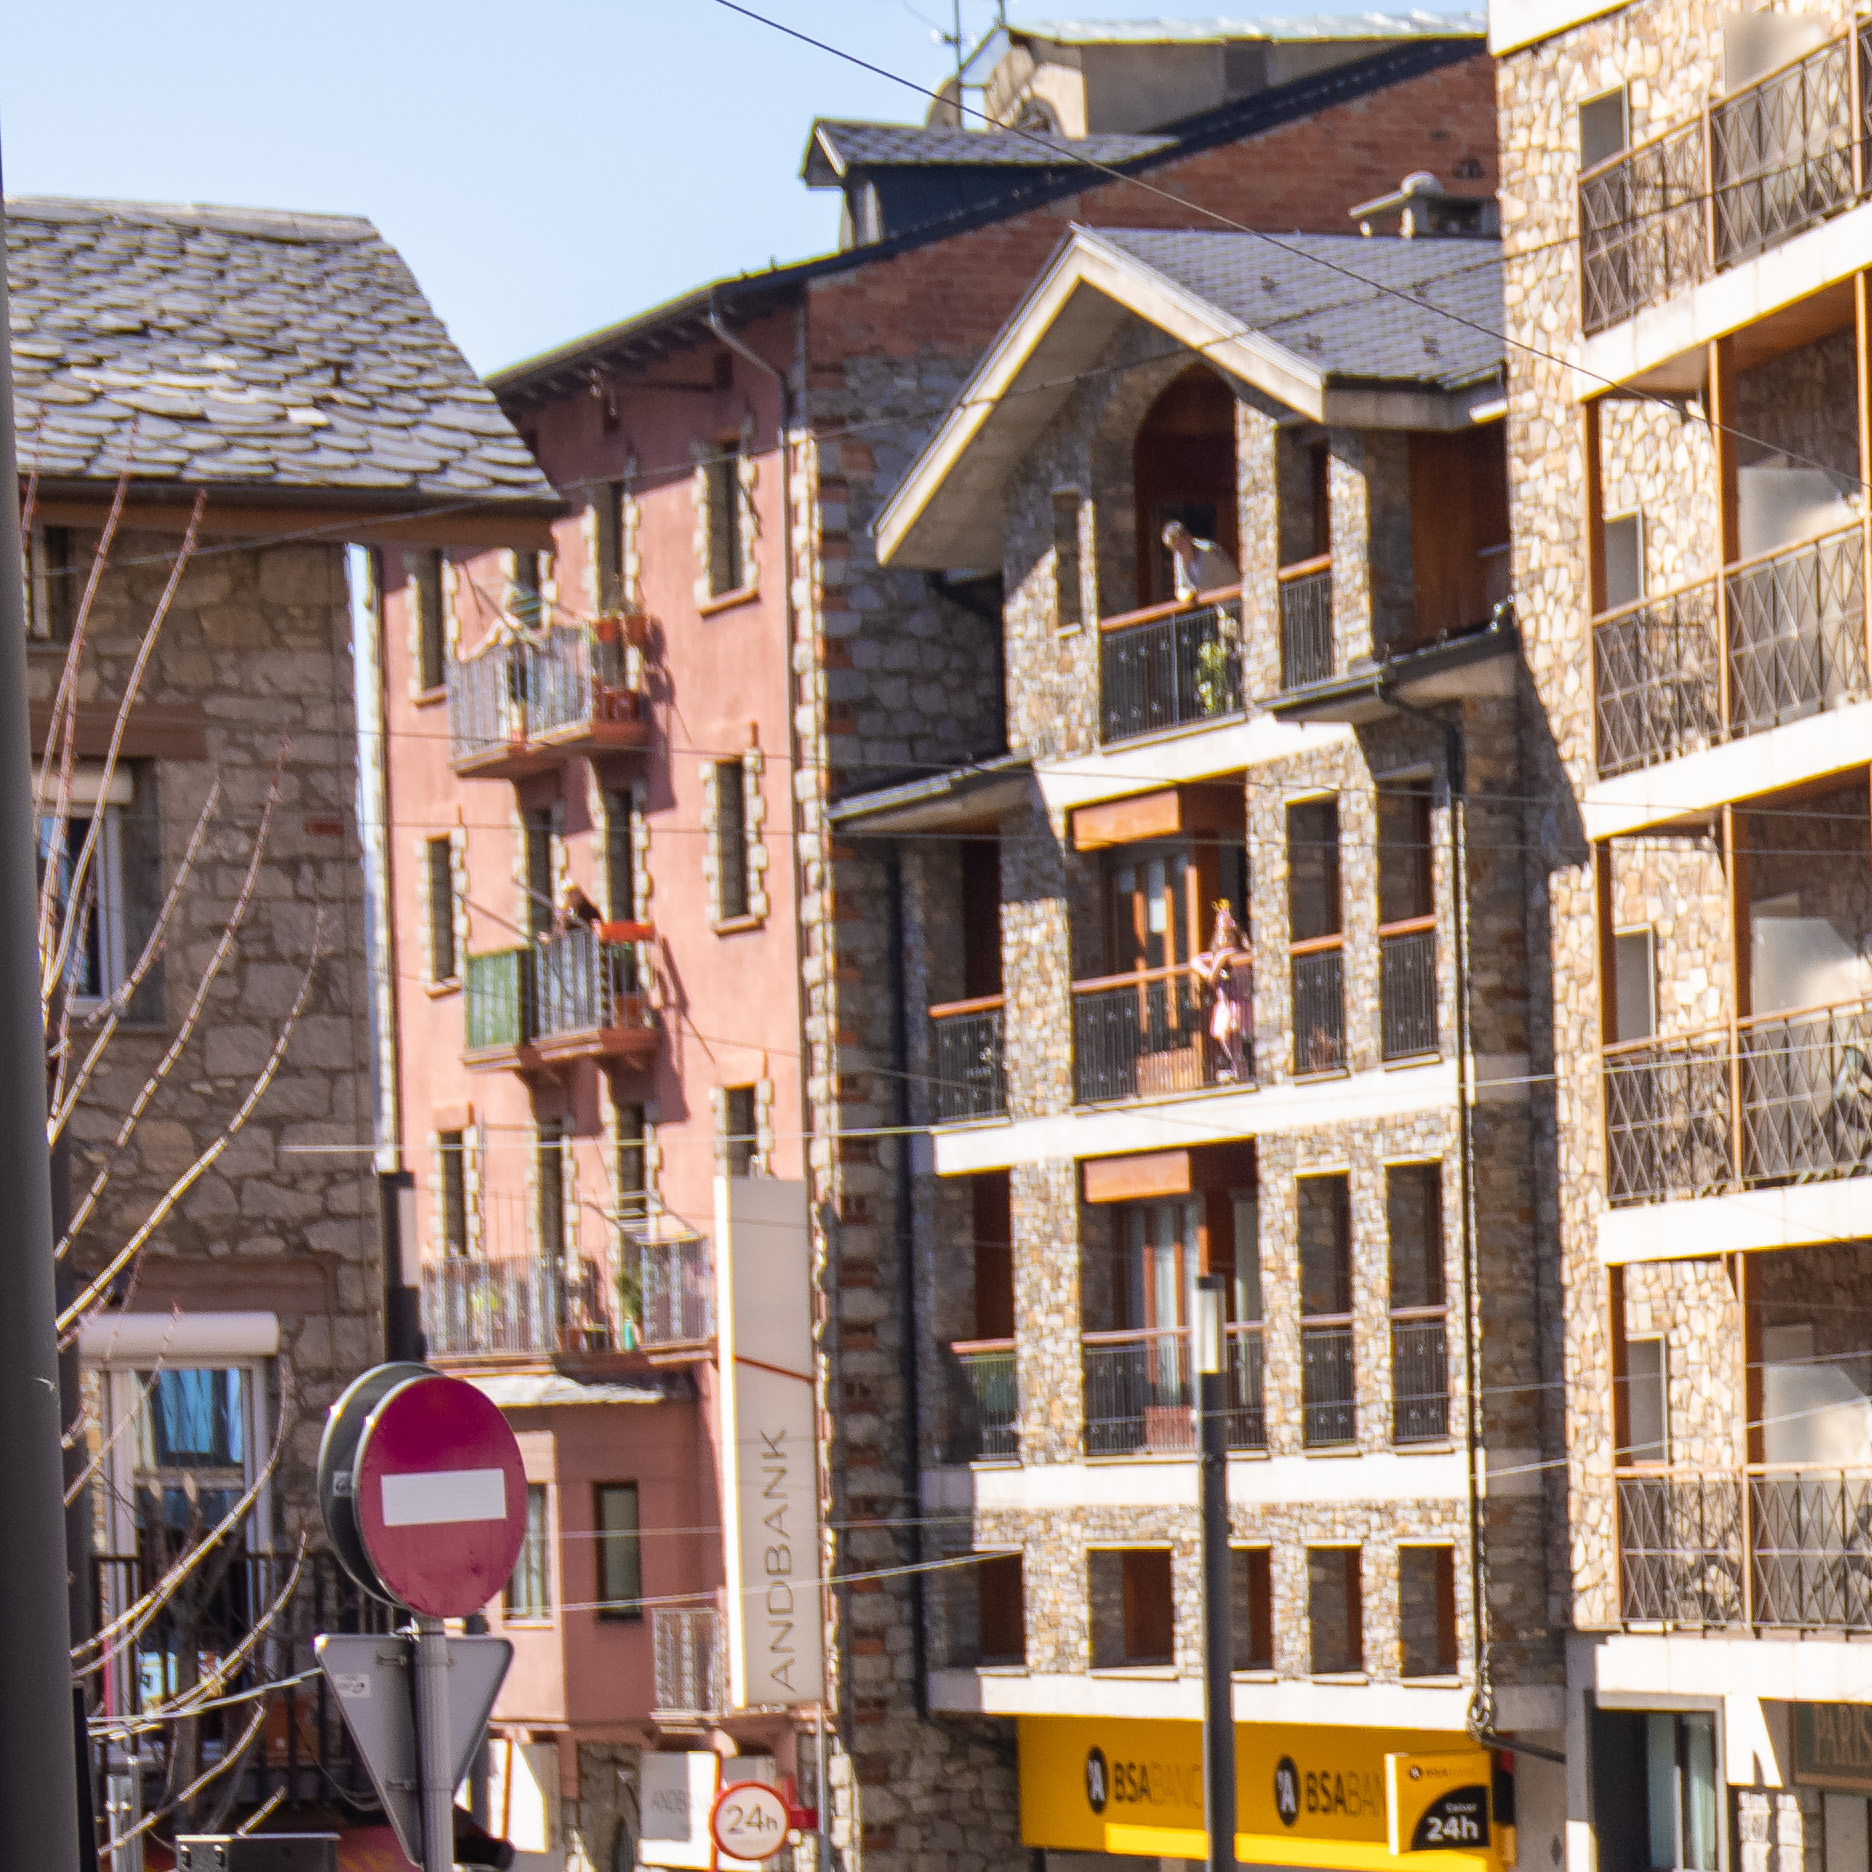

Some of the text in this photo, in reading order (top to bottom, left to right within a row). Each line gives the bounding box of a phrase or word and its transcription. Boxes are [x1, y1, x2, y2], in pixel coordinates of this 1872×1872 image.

[769, 1427, 795, 1693] ANDBANK
[726, 1803, 778, 1834] 24h
[1427, 1815, 1479, 1842] 24h
